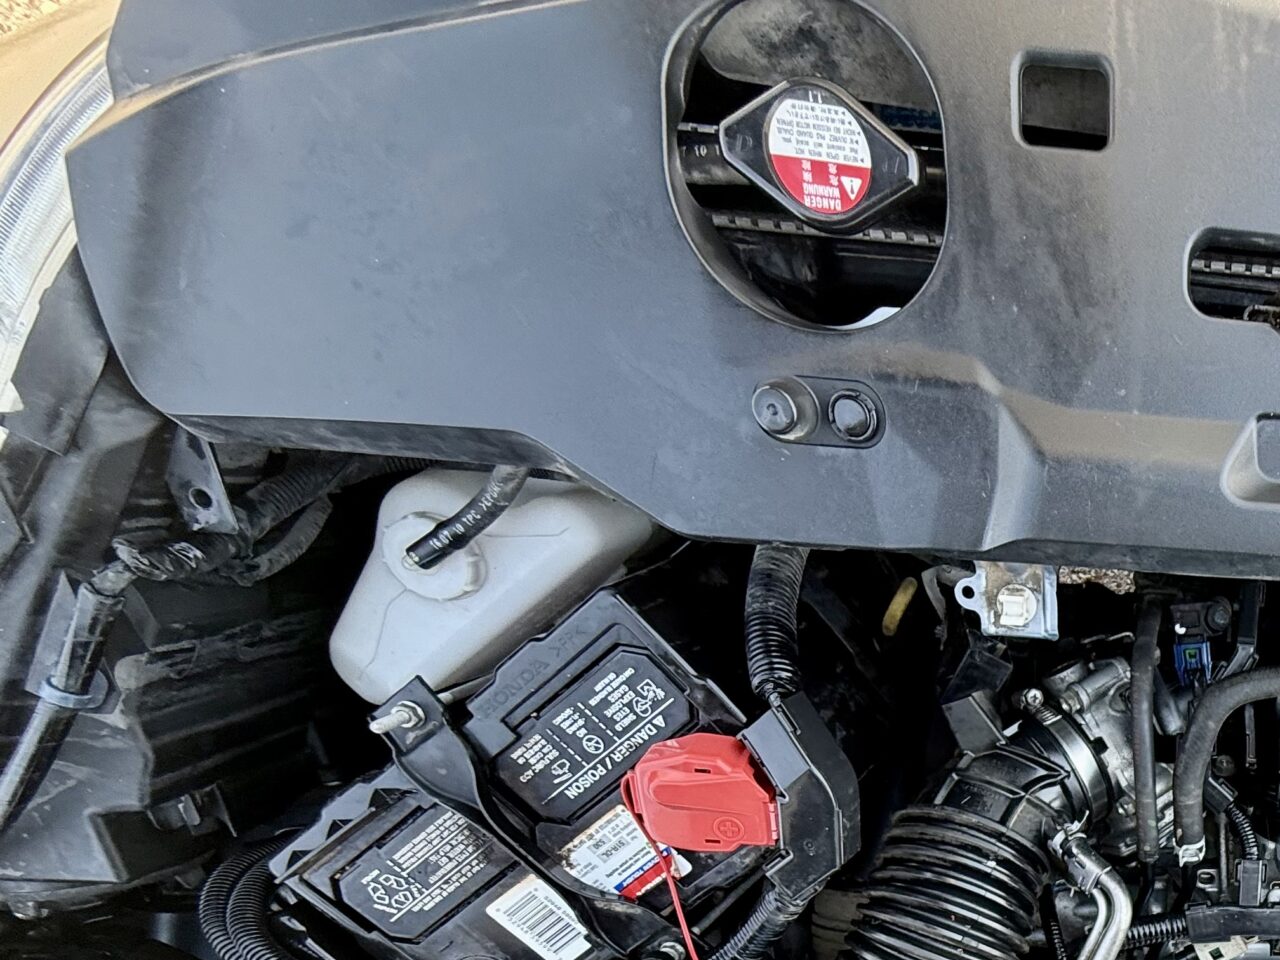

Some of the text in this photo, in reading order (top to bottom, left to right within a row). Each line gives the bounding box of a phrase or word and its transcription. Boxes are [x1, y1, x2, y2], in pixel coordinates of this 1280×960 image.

[807, 149, 822, 158] WHEN
[826, 151, 838, 160] OPEN
[803, 182, 839, 196] WARNUNG
[803, 195, 841, 210] DANGER
[606, 683, 628, 703] GASES
[603, 690, 635, 717] EXPLOSIVE
[612, 705, 629, 721] EYES
[613, 711, 636, 731] SHIELD
[575, 726, 587, 737] NO
[609, 722, 656, 763] DANGER
[532, 749, 559, 771] SULFURIC
[563, 762, 606, 800] POISON
